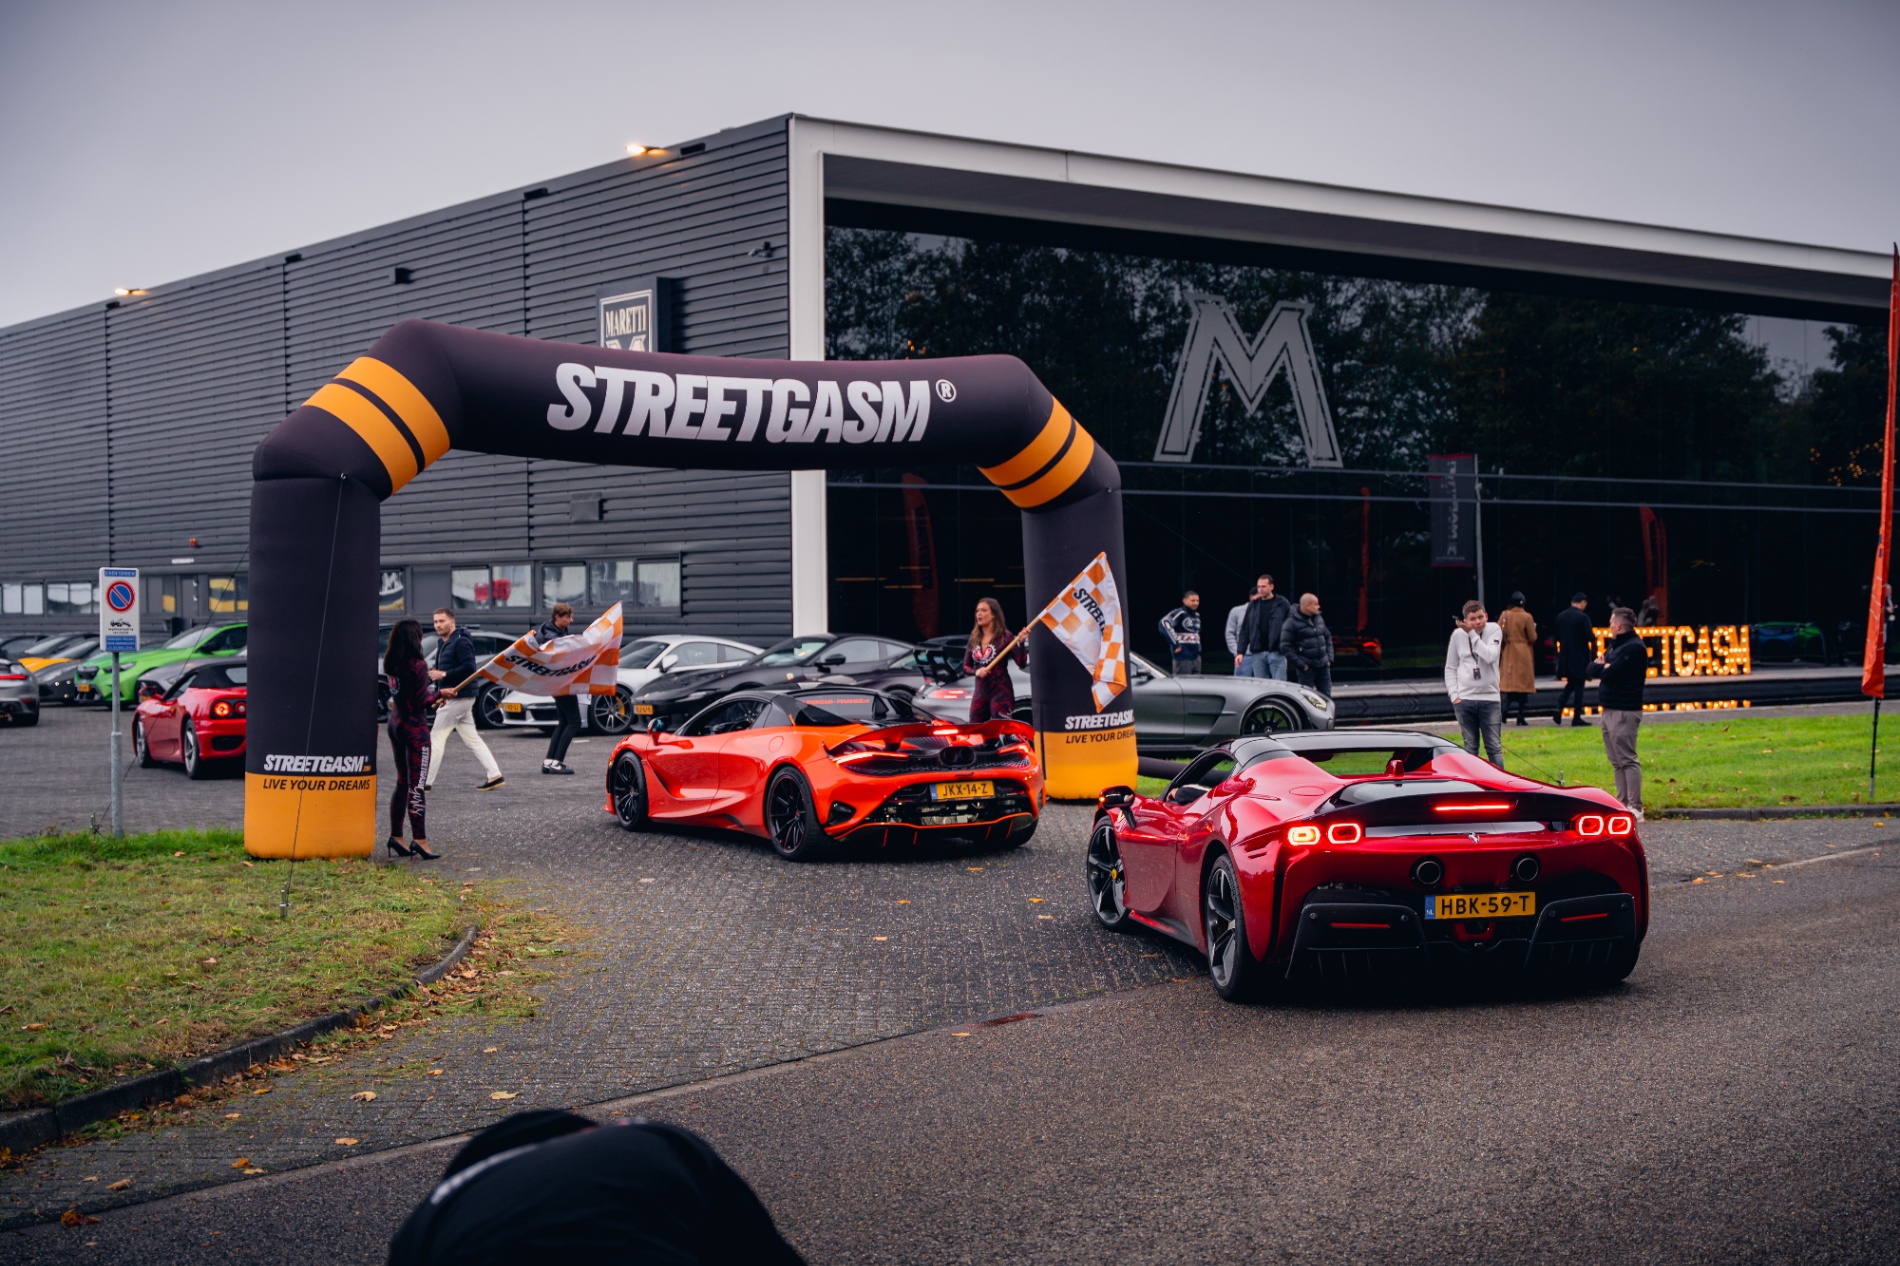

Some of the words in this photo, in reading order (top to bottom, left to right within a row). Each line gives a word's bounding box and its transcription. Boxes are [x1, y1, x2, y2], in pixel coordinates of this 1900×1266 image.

[605, 304, 646, 338] MARETTI
[1066, 734, 1087, 744] LIVE
[1090, 732, 1115, 743] YOUR
[263, 778, 287, 790] LIVE
[290, 780, 326, 791] YOUR
[328, 779, 371, 791] DREAMS
[943, 783, 988, 797] JKX-14-Z
[1441, 896, 1529, 915] HBK-59-T
